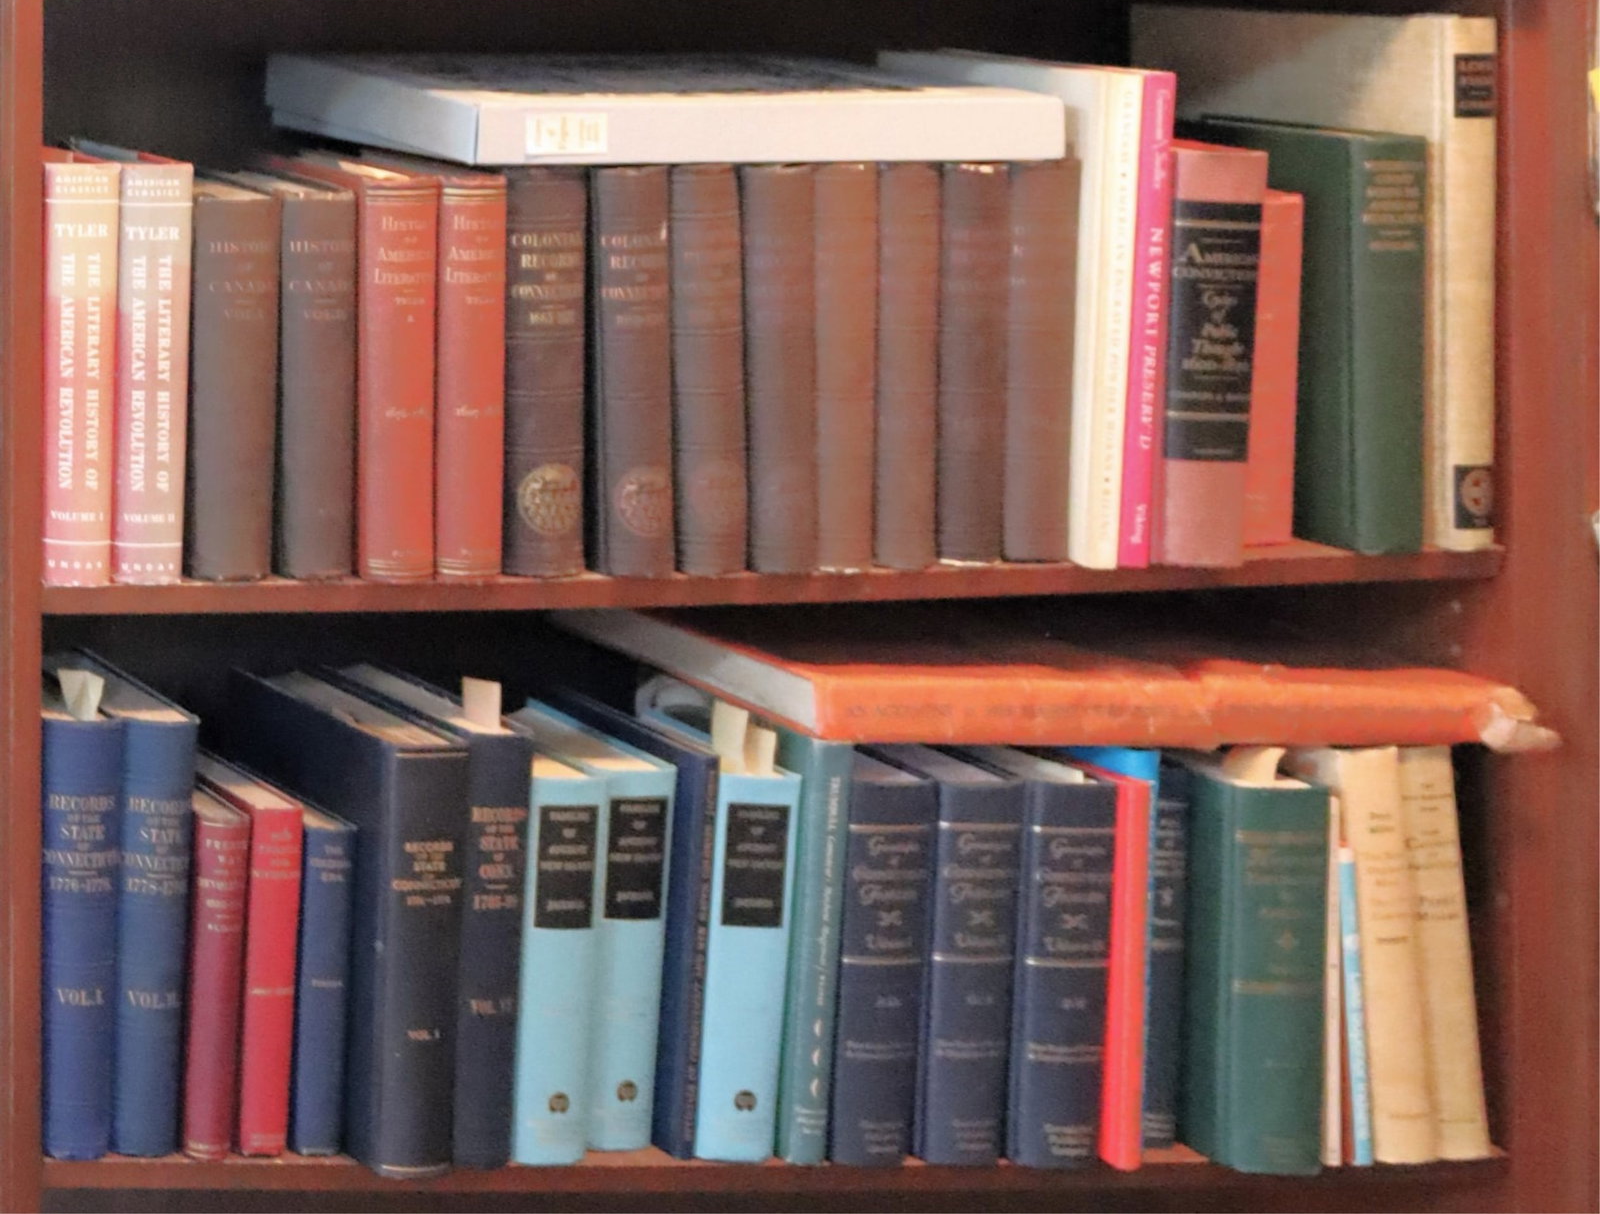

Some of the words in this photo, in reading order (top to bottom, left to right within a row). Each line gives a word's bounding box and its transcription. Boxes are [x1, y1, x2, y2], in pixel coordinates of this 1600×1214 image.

[127, 179, 180, 187] AMERICAN
[54, 223, 109, 237] TYLER
[125, 226, 180, 241] TYLER
[61, 253, 75, 287] THE
[88, 253, 100, 288] THE
[133, 256, 147, 290] THE
[159, 255, 172, 291] THE
[1144, 227, 1164, 335] NEWPORT
[60, 296, 75, 378] AMERICAN
[87, 296, 100, 379] LITERARY
[131, 298, 147, 382] AMERICAN
[158, 298, 172, 383] LITERARY
[58, 387, 74, 490] REVOLUTION
[85, 389, 99, 461] HISTORY
[130, 390, 146, 492] REVOLUTION
[157, 391, 171, 463] HISTORY
[85, 468, 98, 491] OF
[156, 471, 170, 493] OF
[50, 510, 96, 522] VOLUME
[124, 513, 166, 523] VOLUME
[1130, 503, 1148, 545] Viking
[50, 795, 116, 811] RECORDS
